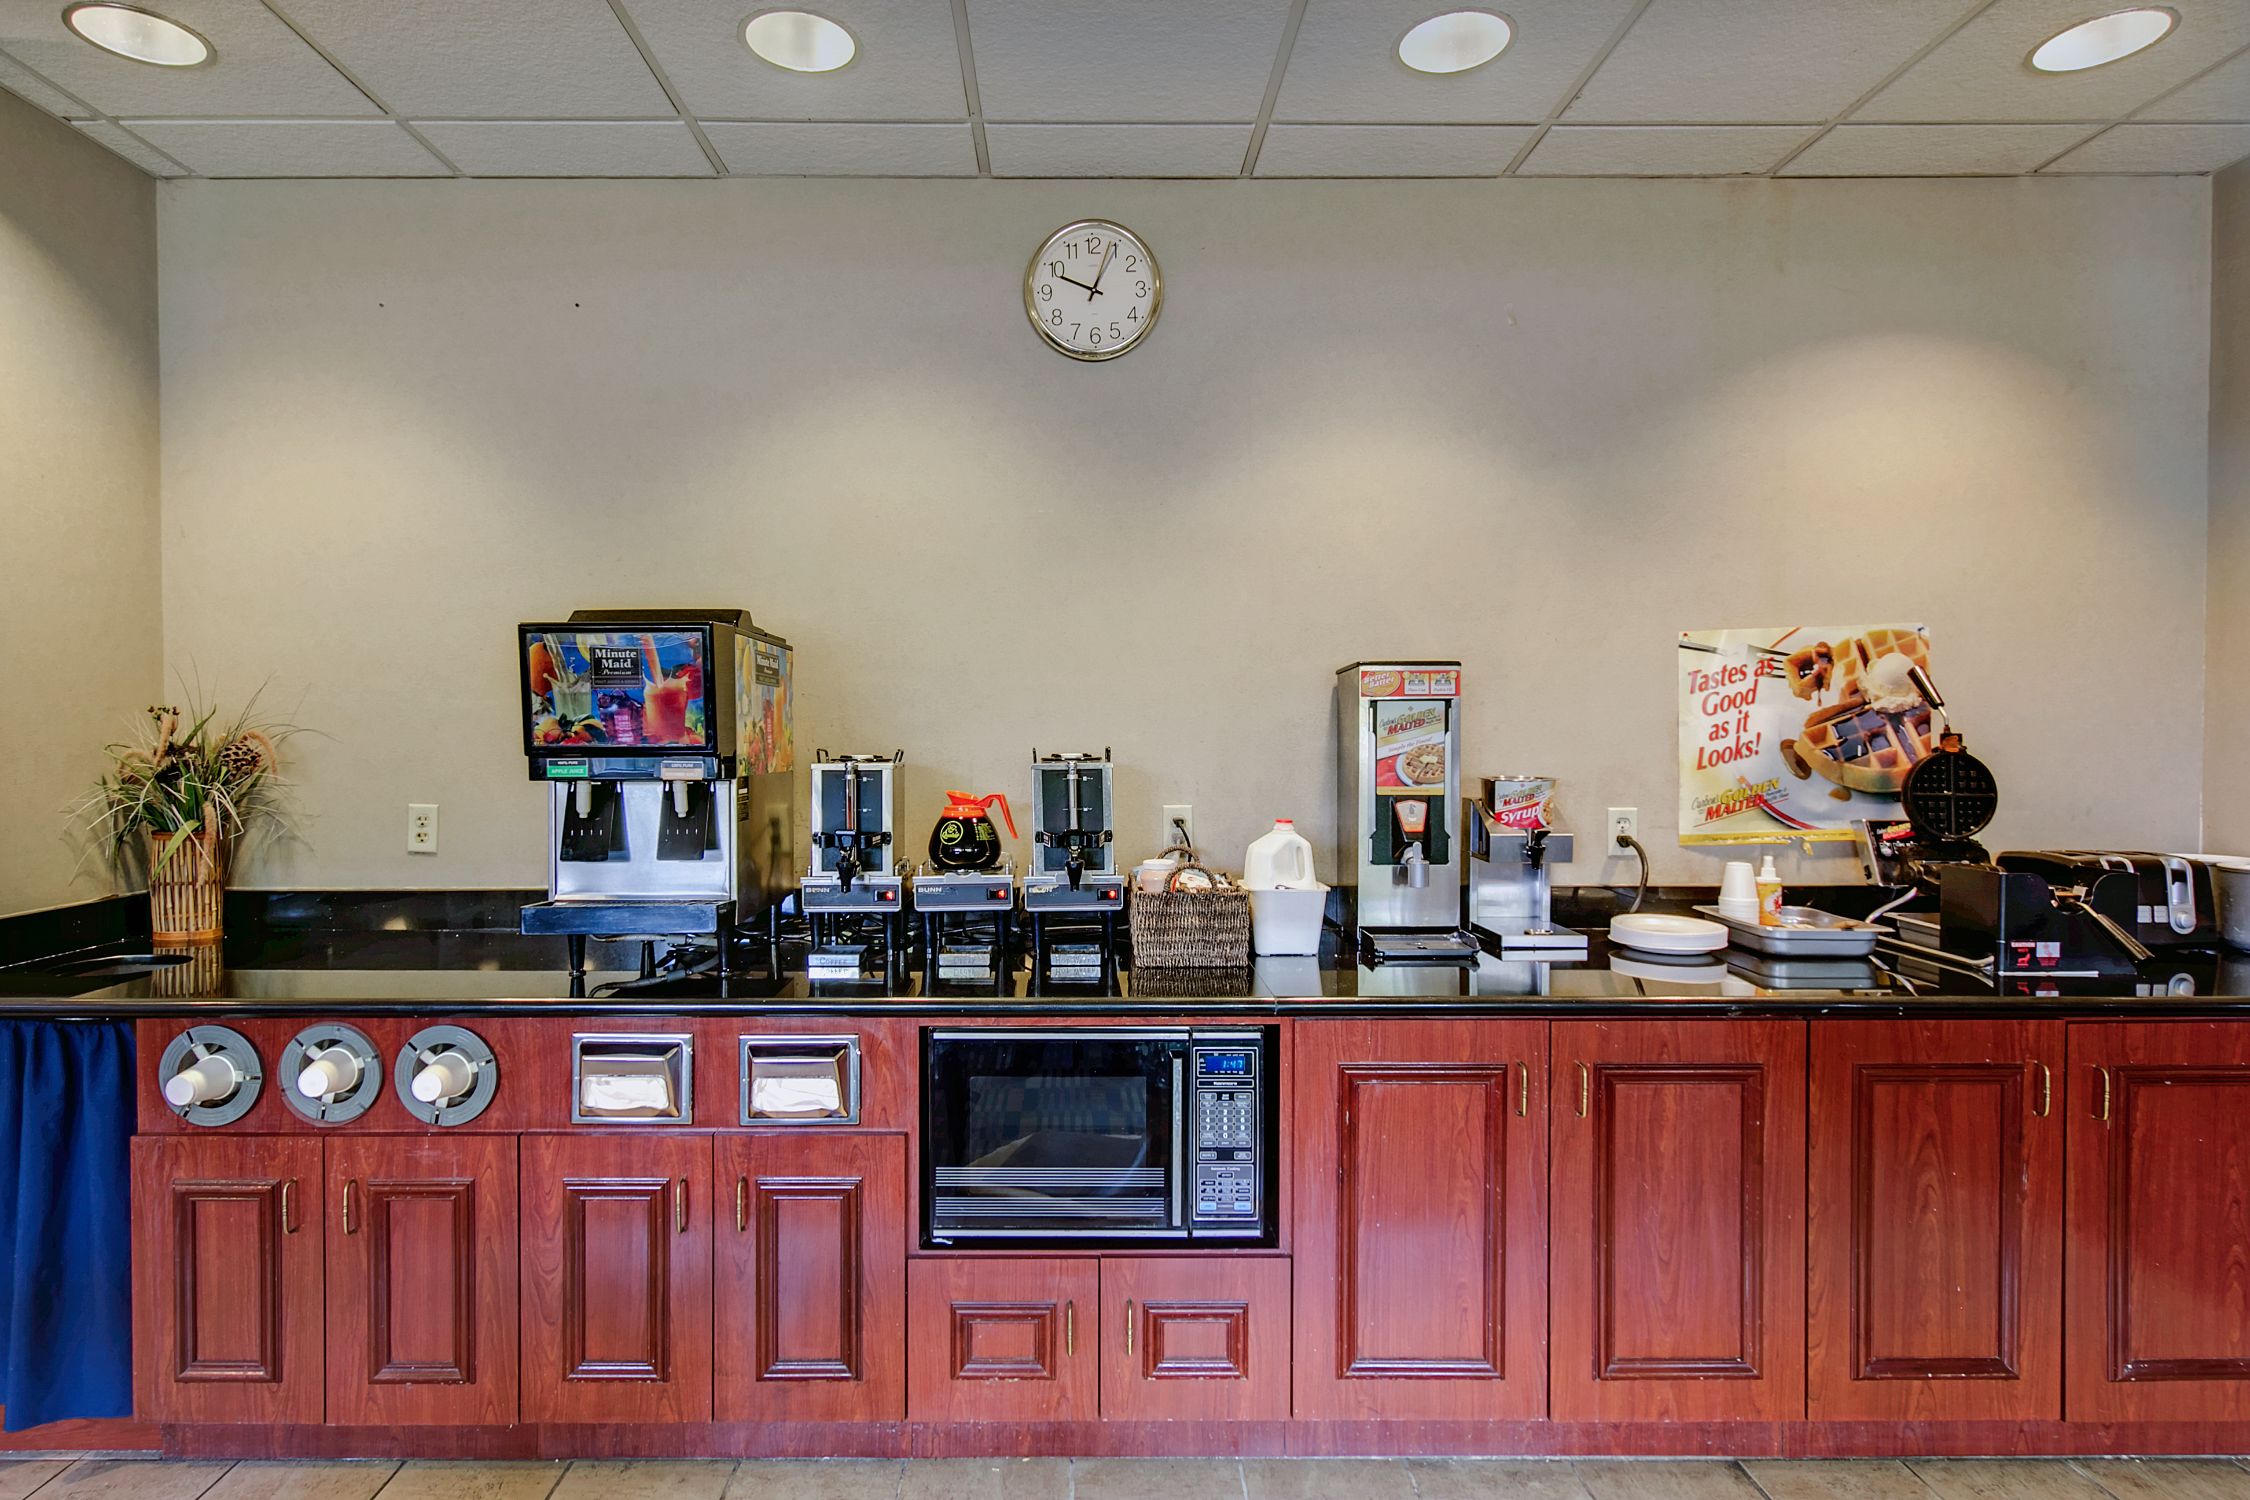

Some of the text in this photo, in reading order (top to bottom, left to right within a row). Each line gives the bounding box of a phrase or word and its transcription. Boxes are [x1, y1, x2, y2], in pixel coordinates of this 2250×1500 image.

[1065, 243, 1077, 259] 11
[1085, 237, 1101, 254] 12
[1111, 242, 1117, 259] 1
[1048, 260, 1065, 278] 10
[1125, 255, 1136, 272] 2
[1041, 284, 1053, 301] 9
[1135, 280, 1147, 298] 3
[1051, 308, 1063, 326] 8
[1127, 306, 1138, 323] 4
[1070, 323, 1081, 340] 7
[1089, 327, 1102, 344] 6
[1109, 322, 1121, 339] 5
[594, 649, 637, 658] Minute
[601, 659, 631, 668] Maid
[1688, 657, 1775, 694] Tastes as
[1702, 678, 1759, 716] Good
[1387, 718, 1426, 736] MALTED
[1708, 709, 1750, 741] as it
[1696, 731, 1762, 770] Looks!
[1719, 777, 1781, 804] GOLDEN
[1503, 793, 1535, 807] MALTED
[1500, 804, 1541, 824] Syrup
[1222, 1060, 1243, 1069] 1:47
